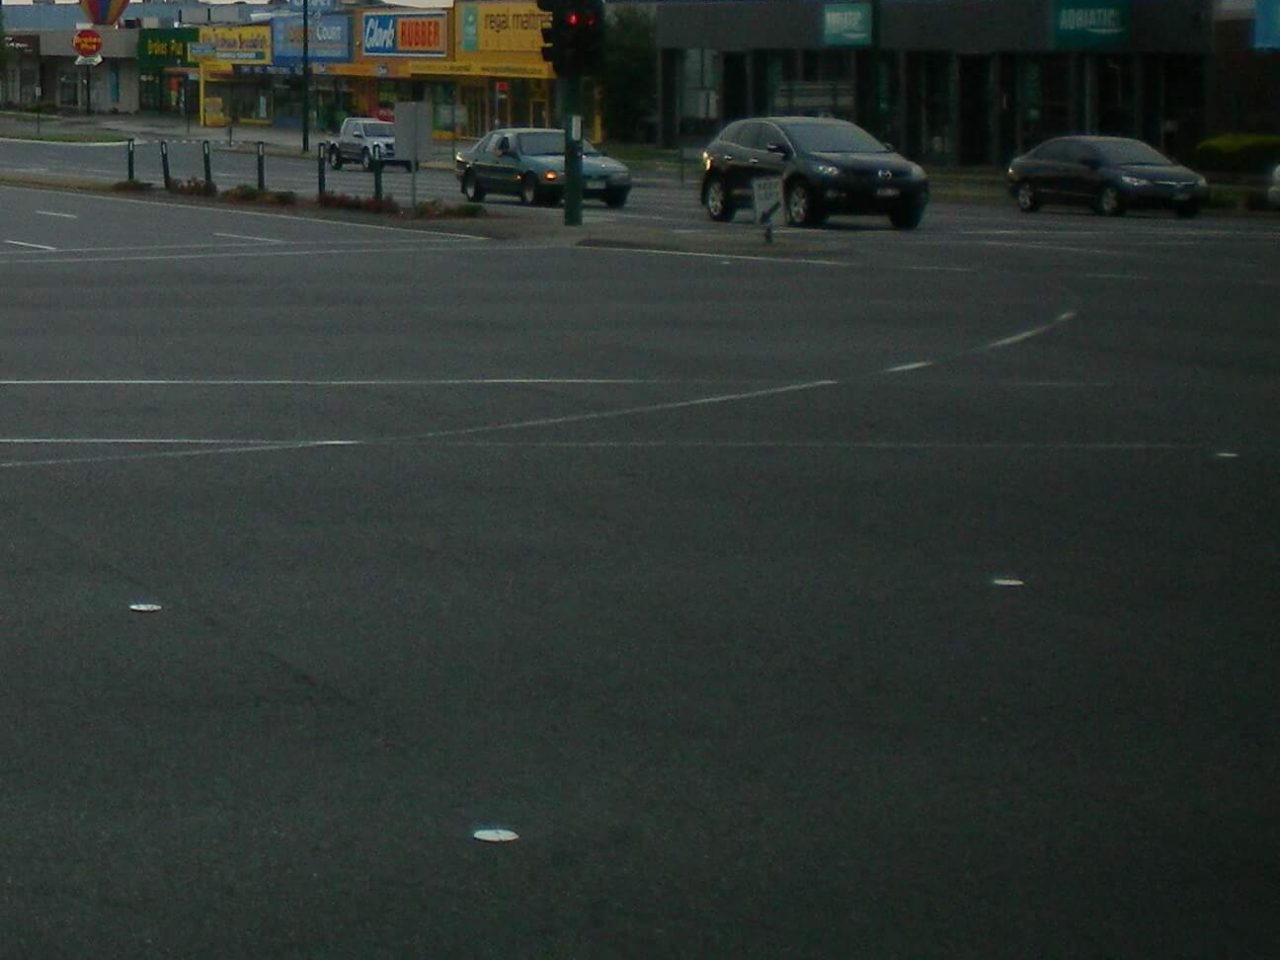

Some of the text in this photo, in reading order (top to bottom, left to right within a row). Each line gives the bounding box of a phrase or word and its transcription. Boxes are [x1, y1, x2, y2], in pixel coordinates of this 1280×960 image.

[365, 17, 441, 50] Clark RUBBER
[484, 8, 510, 33] regal
